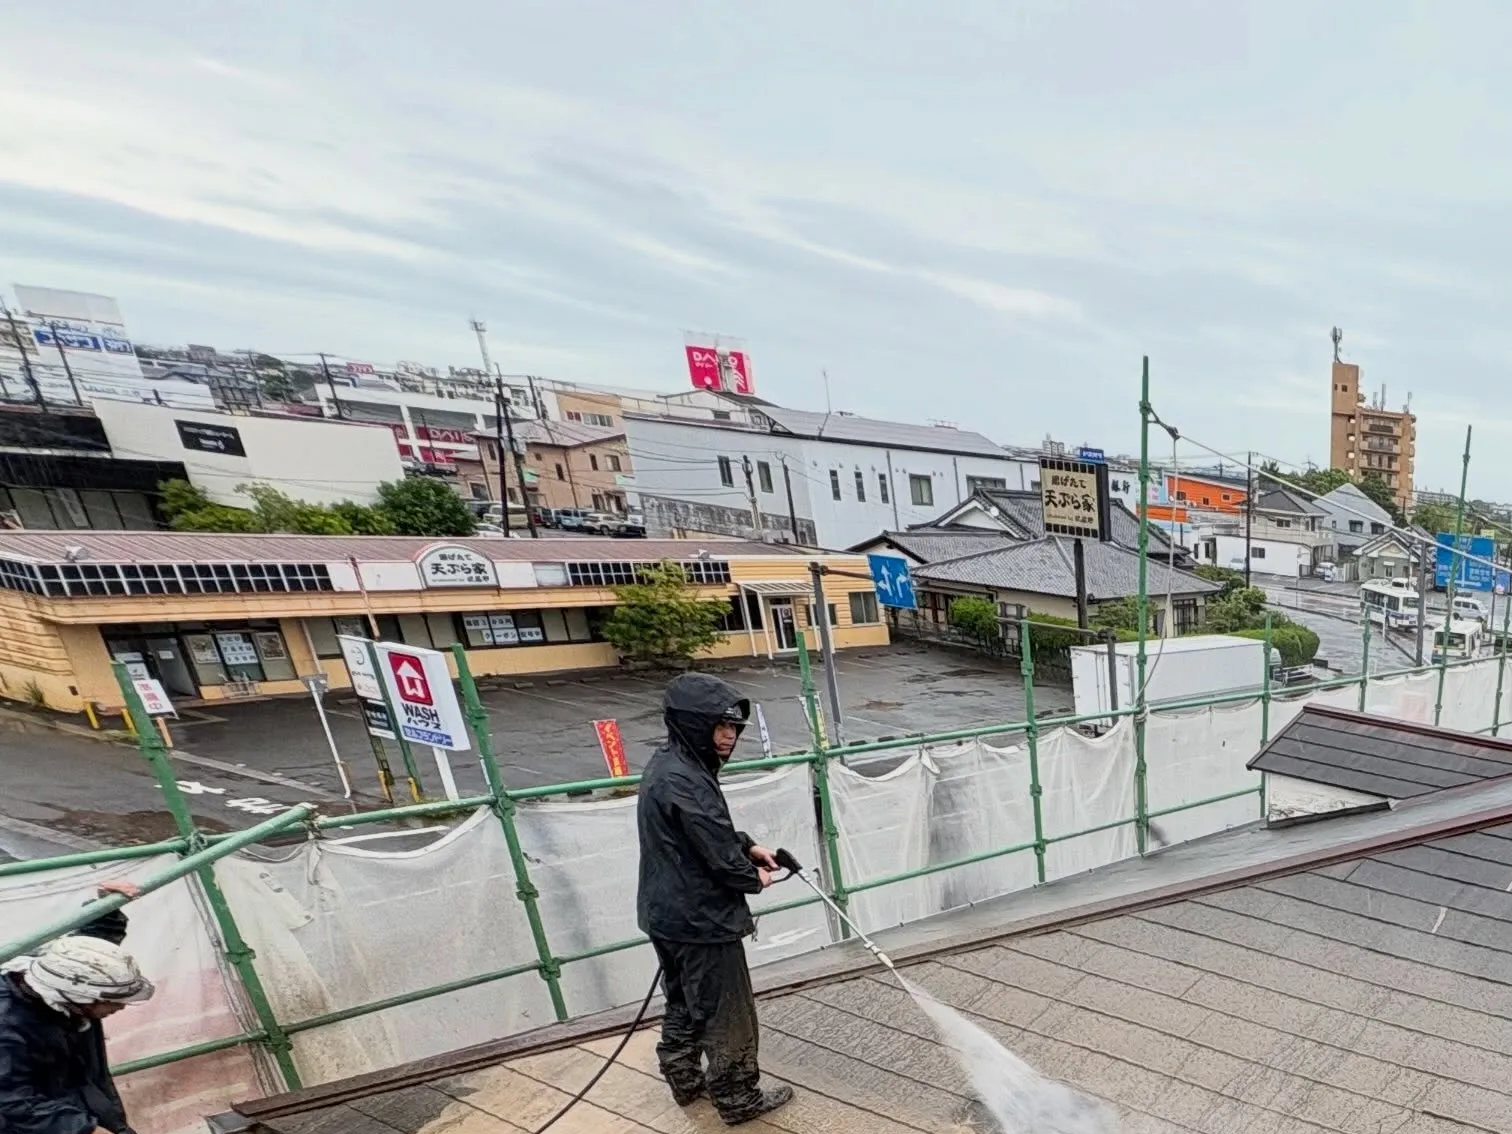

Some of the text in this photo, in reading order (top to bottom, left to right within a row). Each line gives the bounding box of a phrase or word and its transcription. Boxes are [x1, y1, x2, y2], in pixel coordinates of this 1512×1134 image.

[1045, 489, 1095, 512] 天ぷら家
[431, 562, 487, 575] 天ぷら家
[401, 703, 440, 722] WASH
